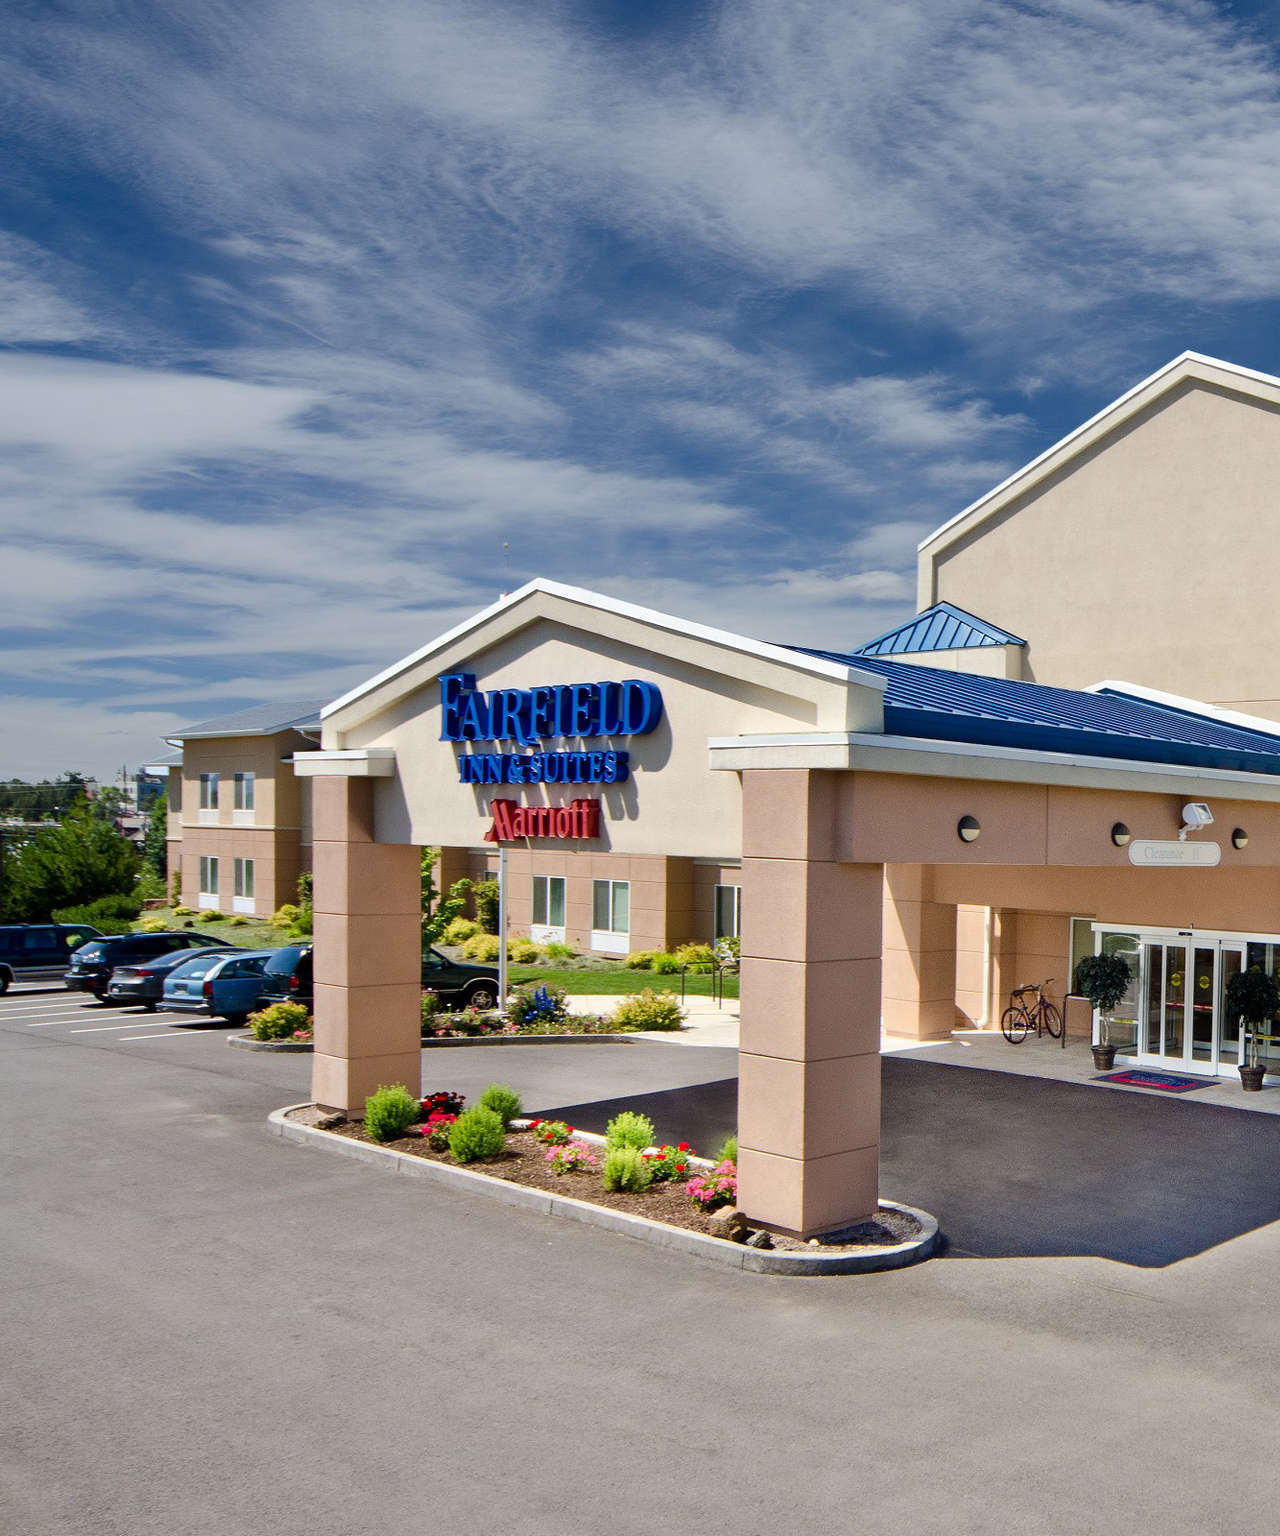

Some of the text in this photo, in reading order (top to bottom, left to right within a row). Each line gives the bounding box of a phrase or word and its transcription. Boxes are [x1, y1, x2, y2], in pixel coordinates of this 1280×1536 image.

[437, 674, 662, 748] FAIRFIELD
[458, 751, 629, 784] INN & SUITES
[483, 798, 600, 842] Marriott
